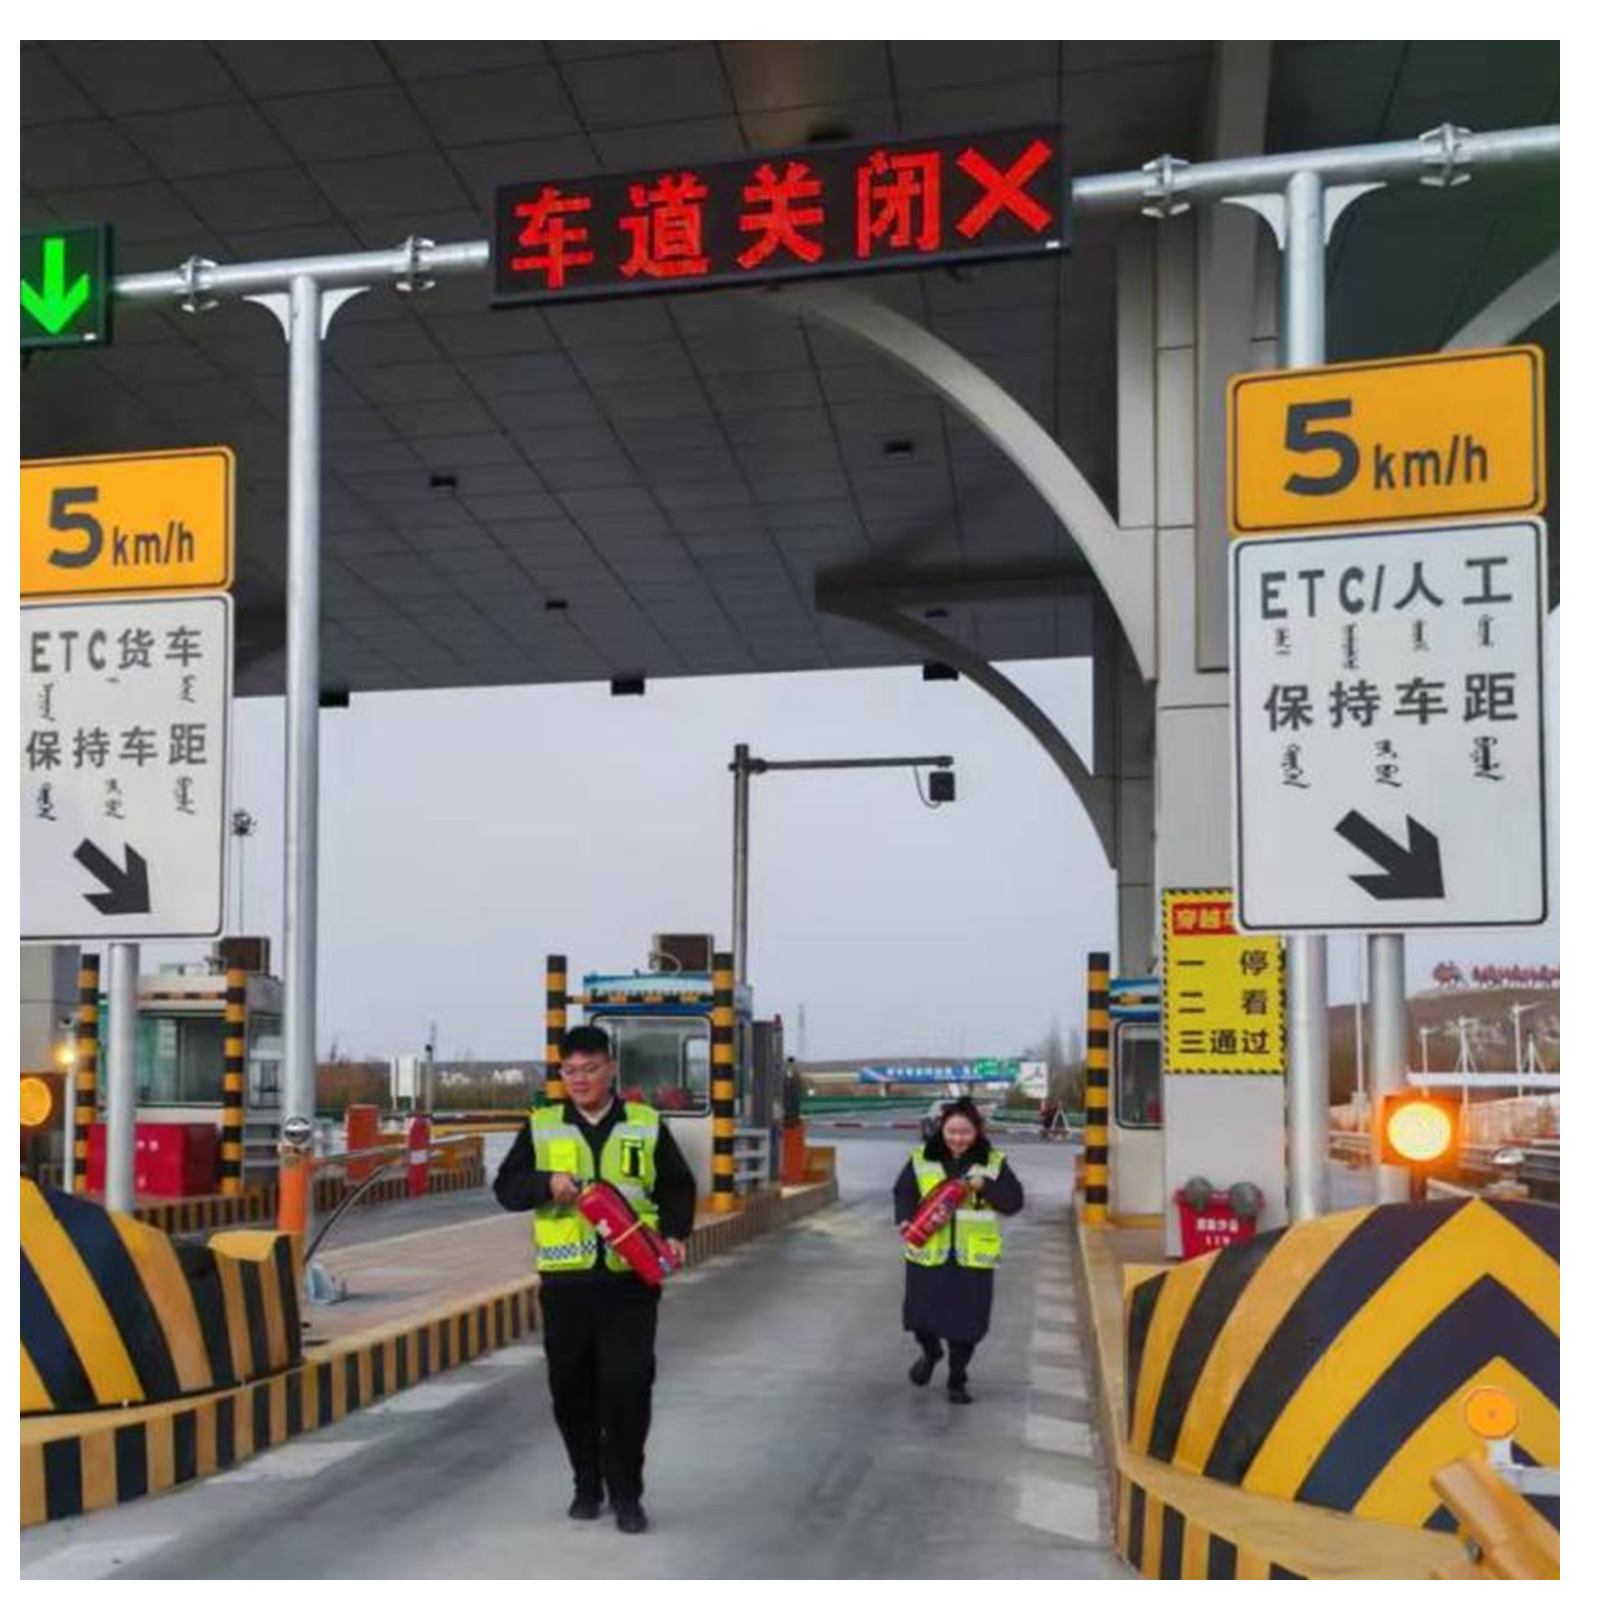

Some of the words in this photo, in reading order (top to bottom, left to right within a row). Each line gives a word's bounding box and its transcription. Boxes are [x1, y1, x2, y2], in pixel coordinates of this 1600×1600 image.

[511, 149, 942, 290] 车道关闭
[1263, 671, 1519, 733] 保持车距
[25, 722, 208, 771] 保持车距
[1177, 1028, 1271, 1055] 三通过
